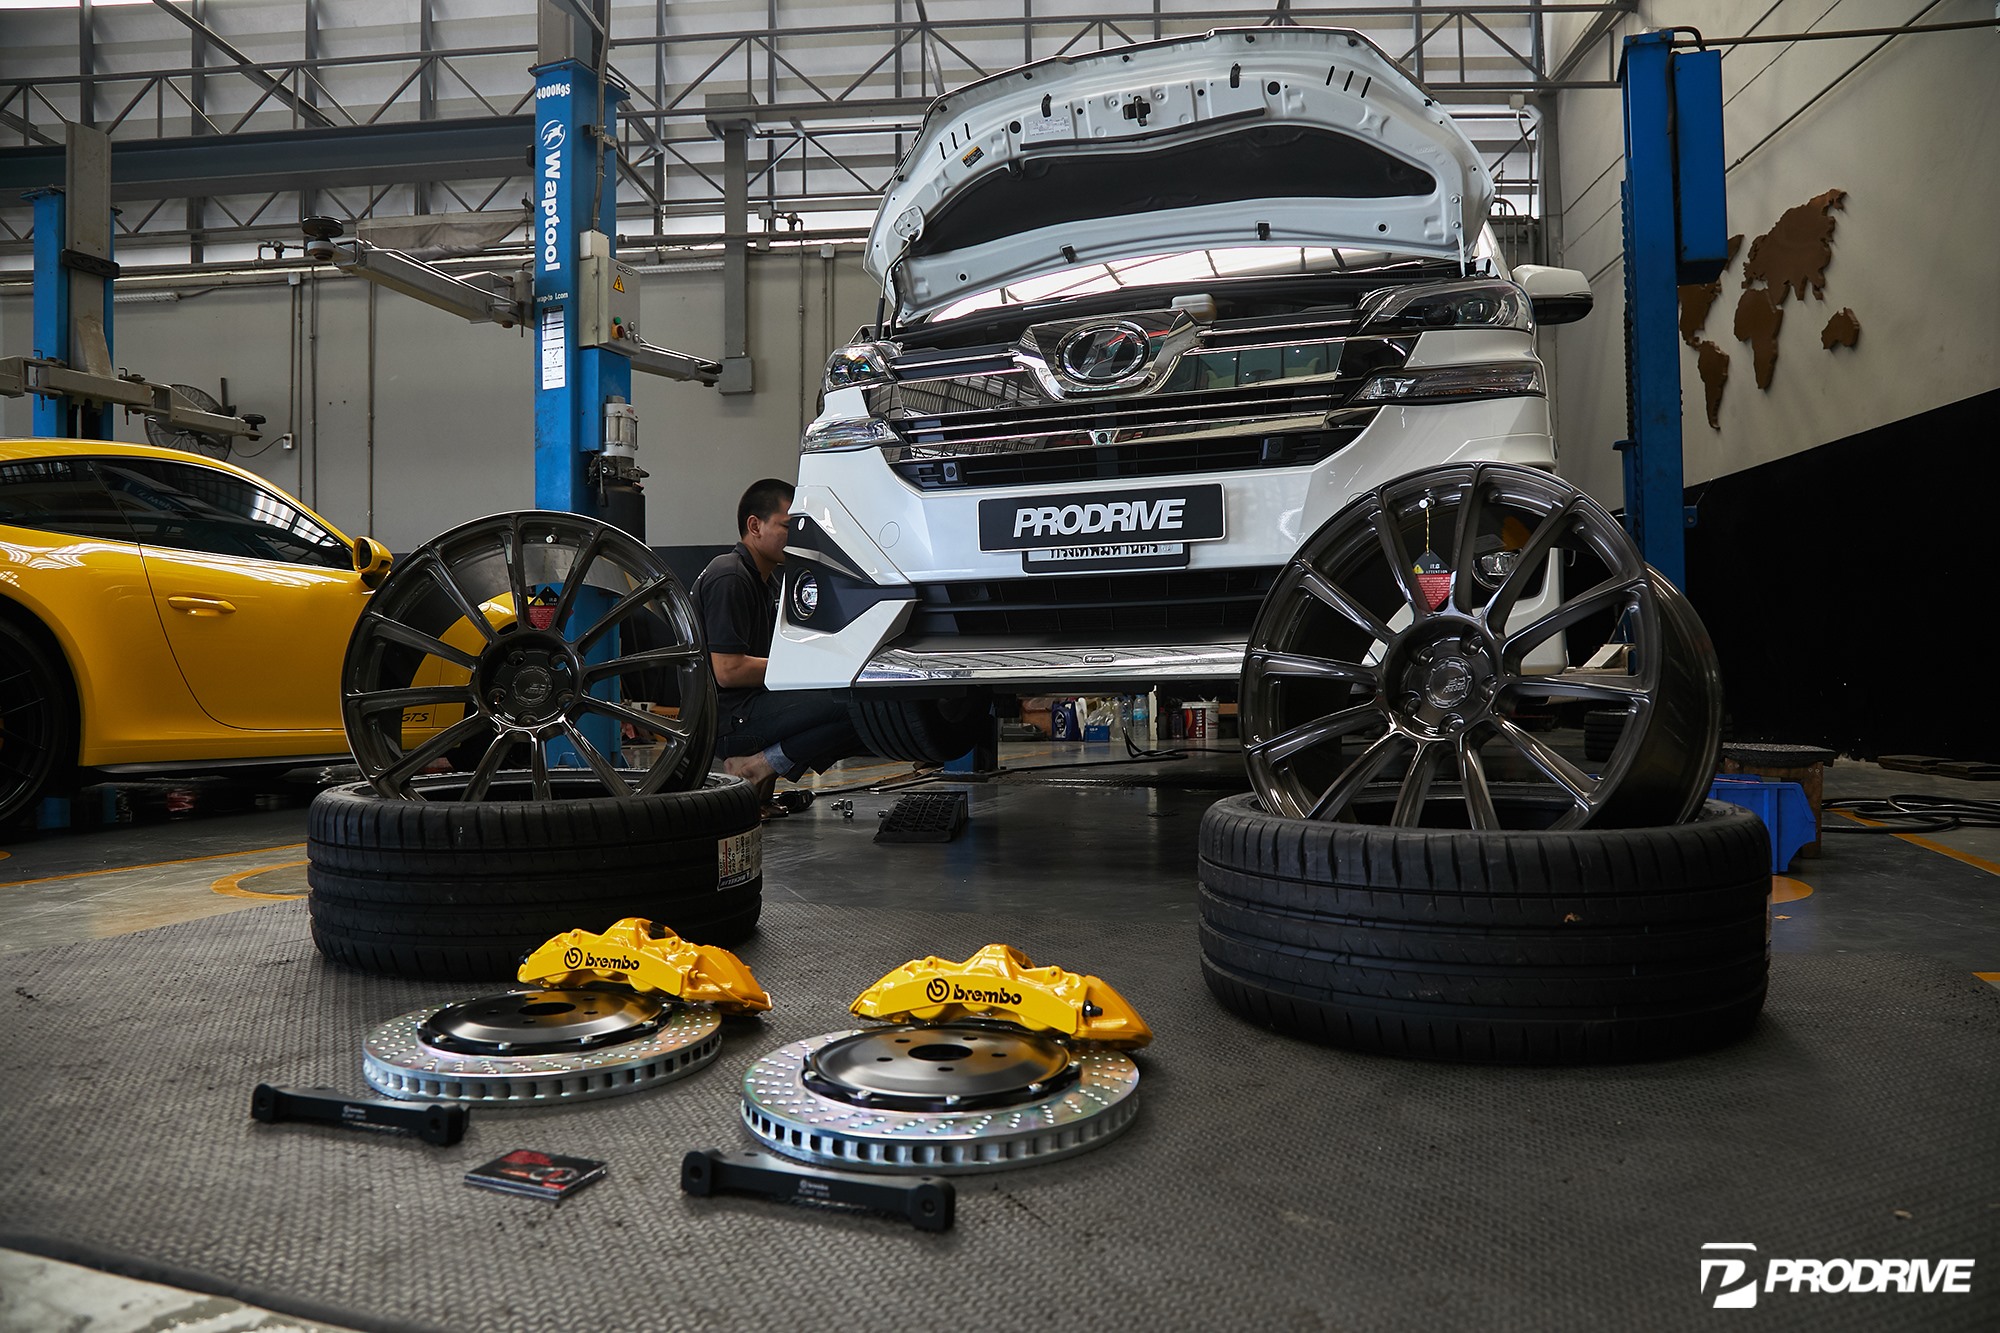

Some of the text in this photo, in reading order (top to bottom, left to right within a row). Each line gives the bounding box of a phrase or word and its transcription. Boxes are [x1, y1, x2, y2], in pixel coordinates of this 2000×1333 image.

[536, 83, 571, 100] 4000Kgs
[541, 150, 561, 272] Waptool
[1013, 498, 1186, 538] PRODRIVE
[402, 712, 429, 722] GTS
[585, 952, 640, 971] brembo
[953, 984, 1022, 1005] brembo
